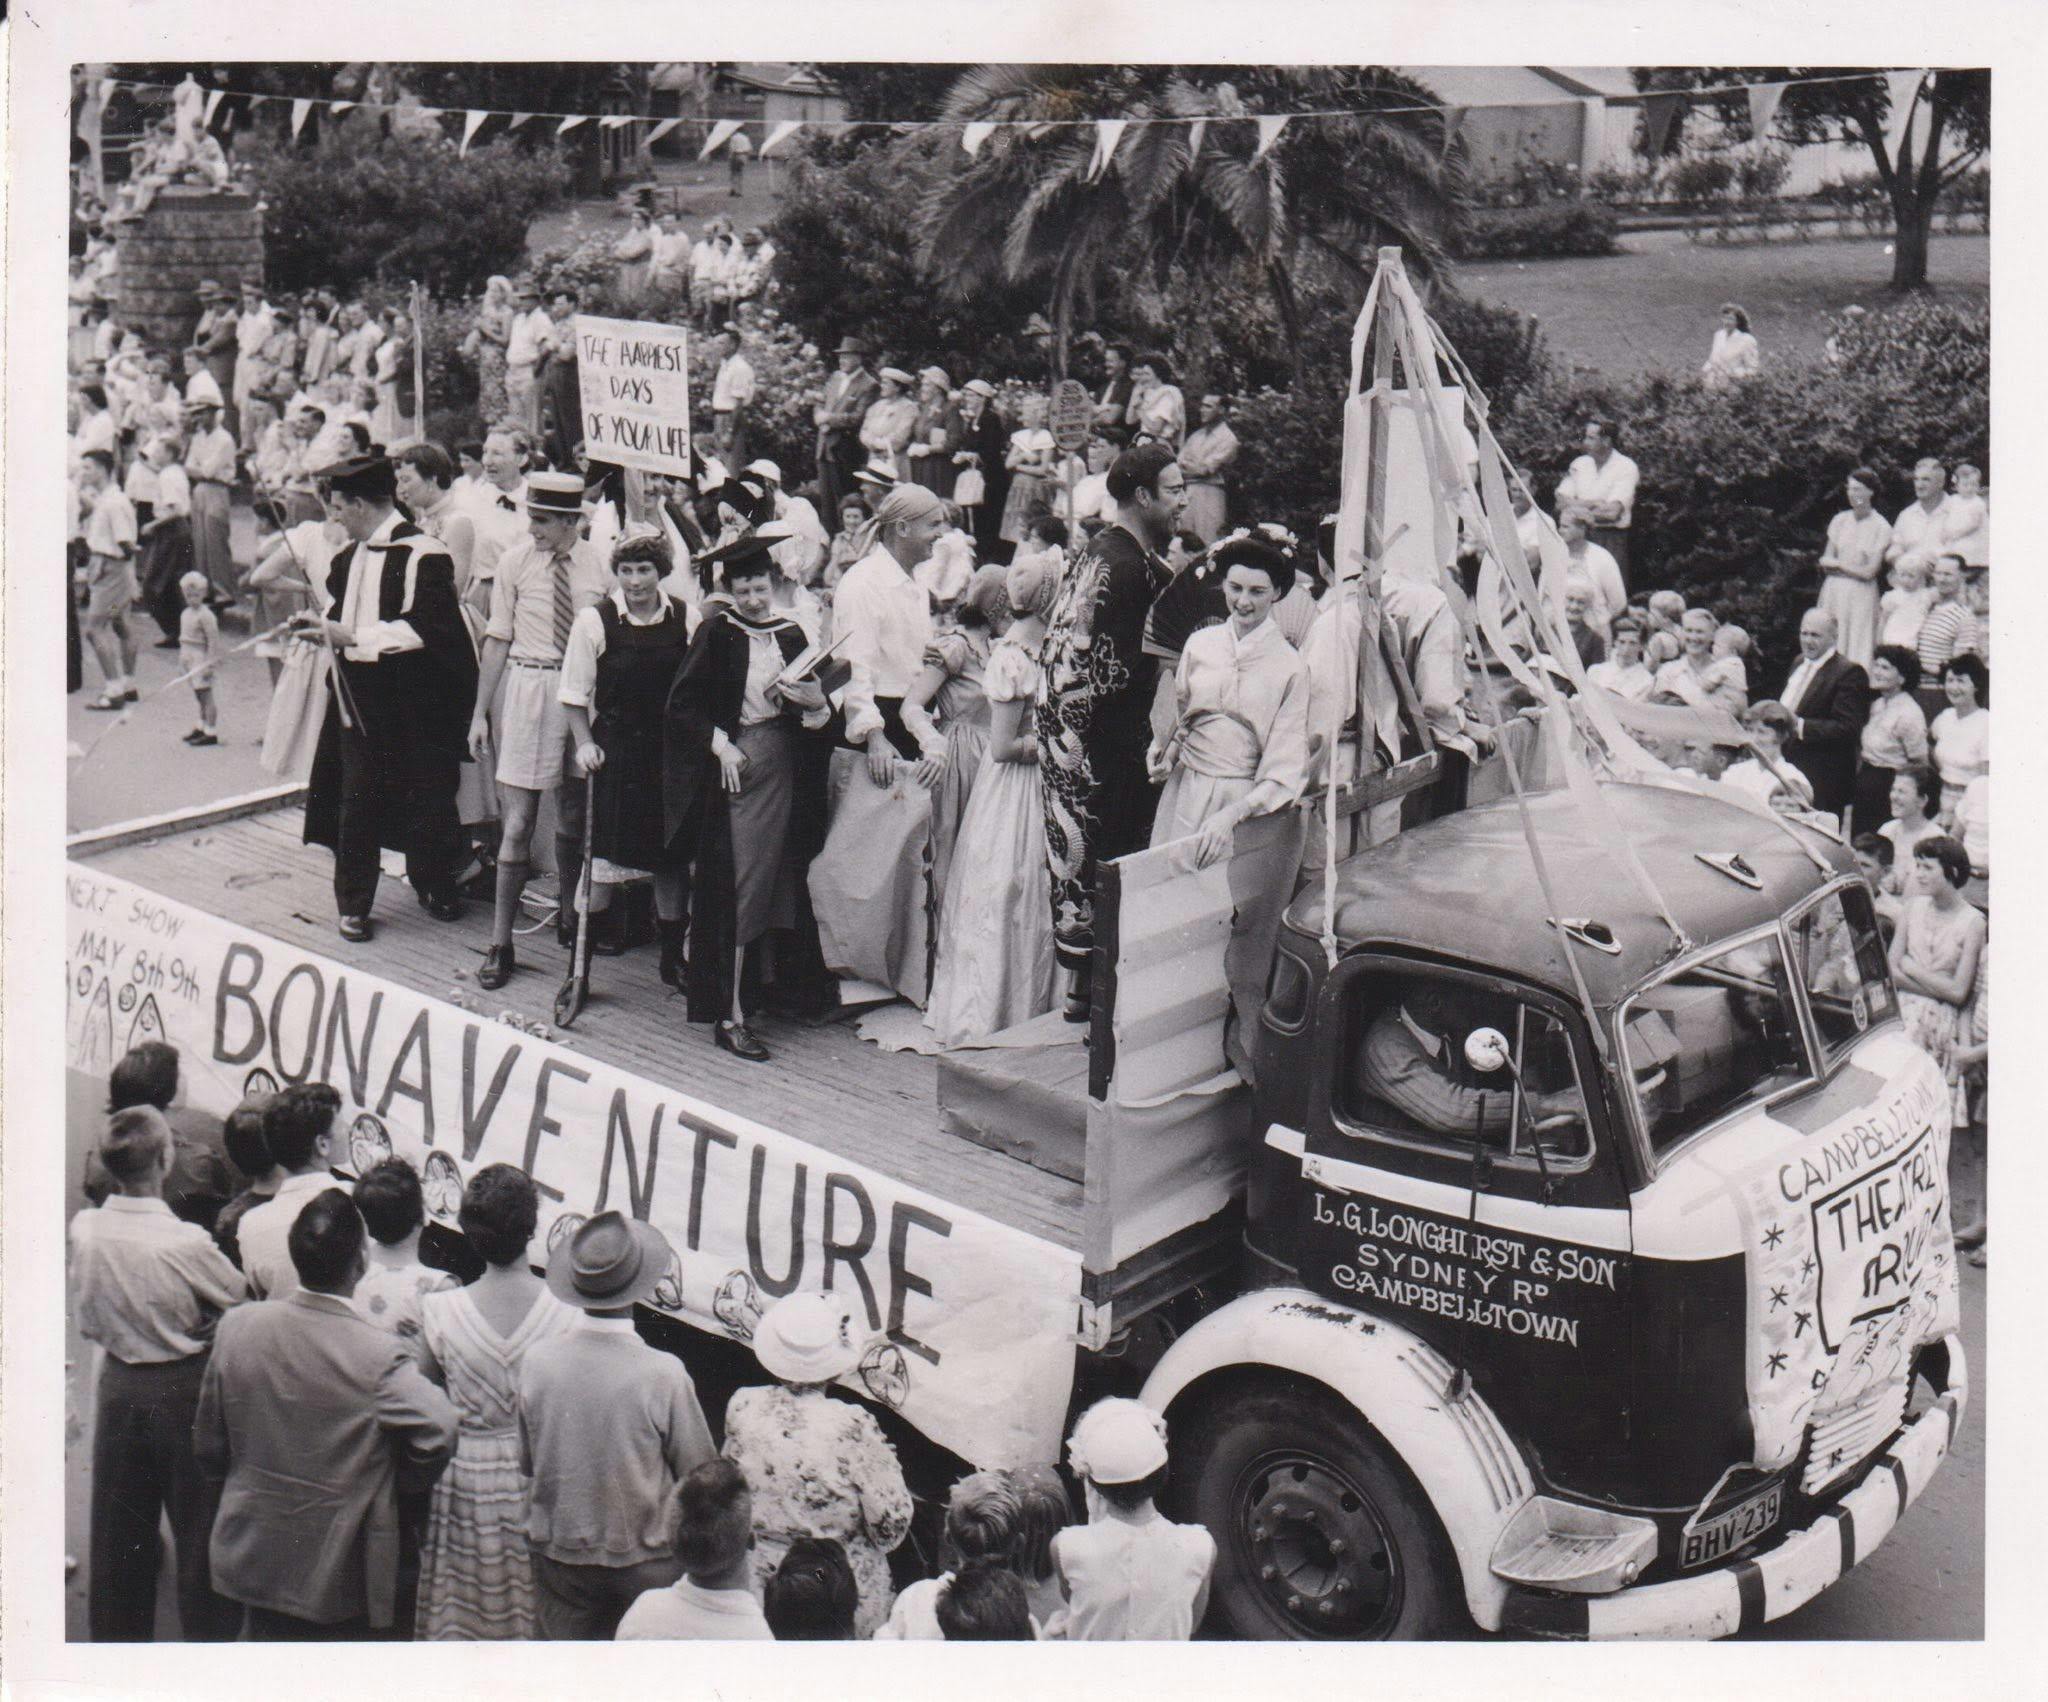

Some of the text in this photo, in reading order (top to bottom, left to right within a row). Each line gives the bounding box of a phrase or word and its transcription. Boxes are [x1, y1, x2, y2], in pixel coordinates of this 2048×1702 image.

[583, 335, 613, 367] THE
[610, 376, 653, 405] DAYS
[588, 413, 689, 460] OF YOUR LIFE
[128, 898, 185, 939] SHOW
[75, 929, 126, 970] MAY
[212, 941, 952, 1367] BONAVENTURE
[1358, 1243, 1549, 1304] SYDNEY RD
[1556, 1249, 1617, 1292] SON
[1331, 1264, 1579, 1348] CAMPBELLTOWN
